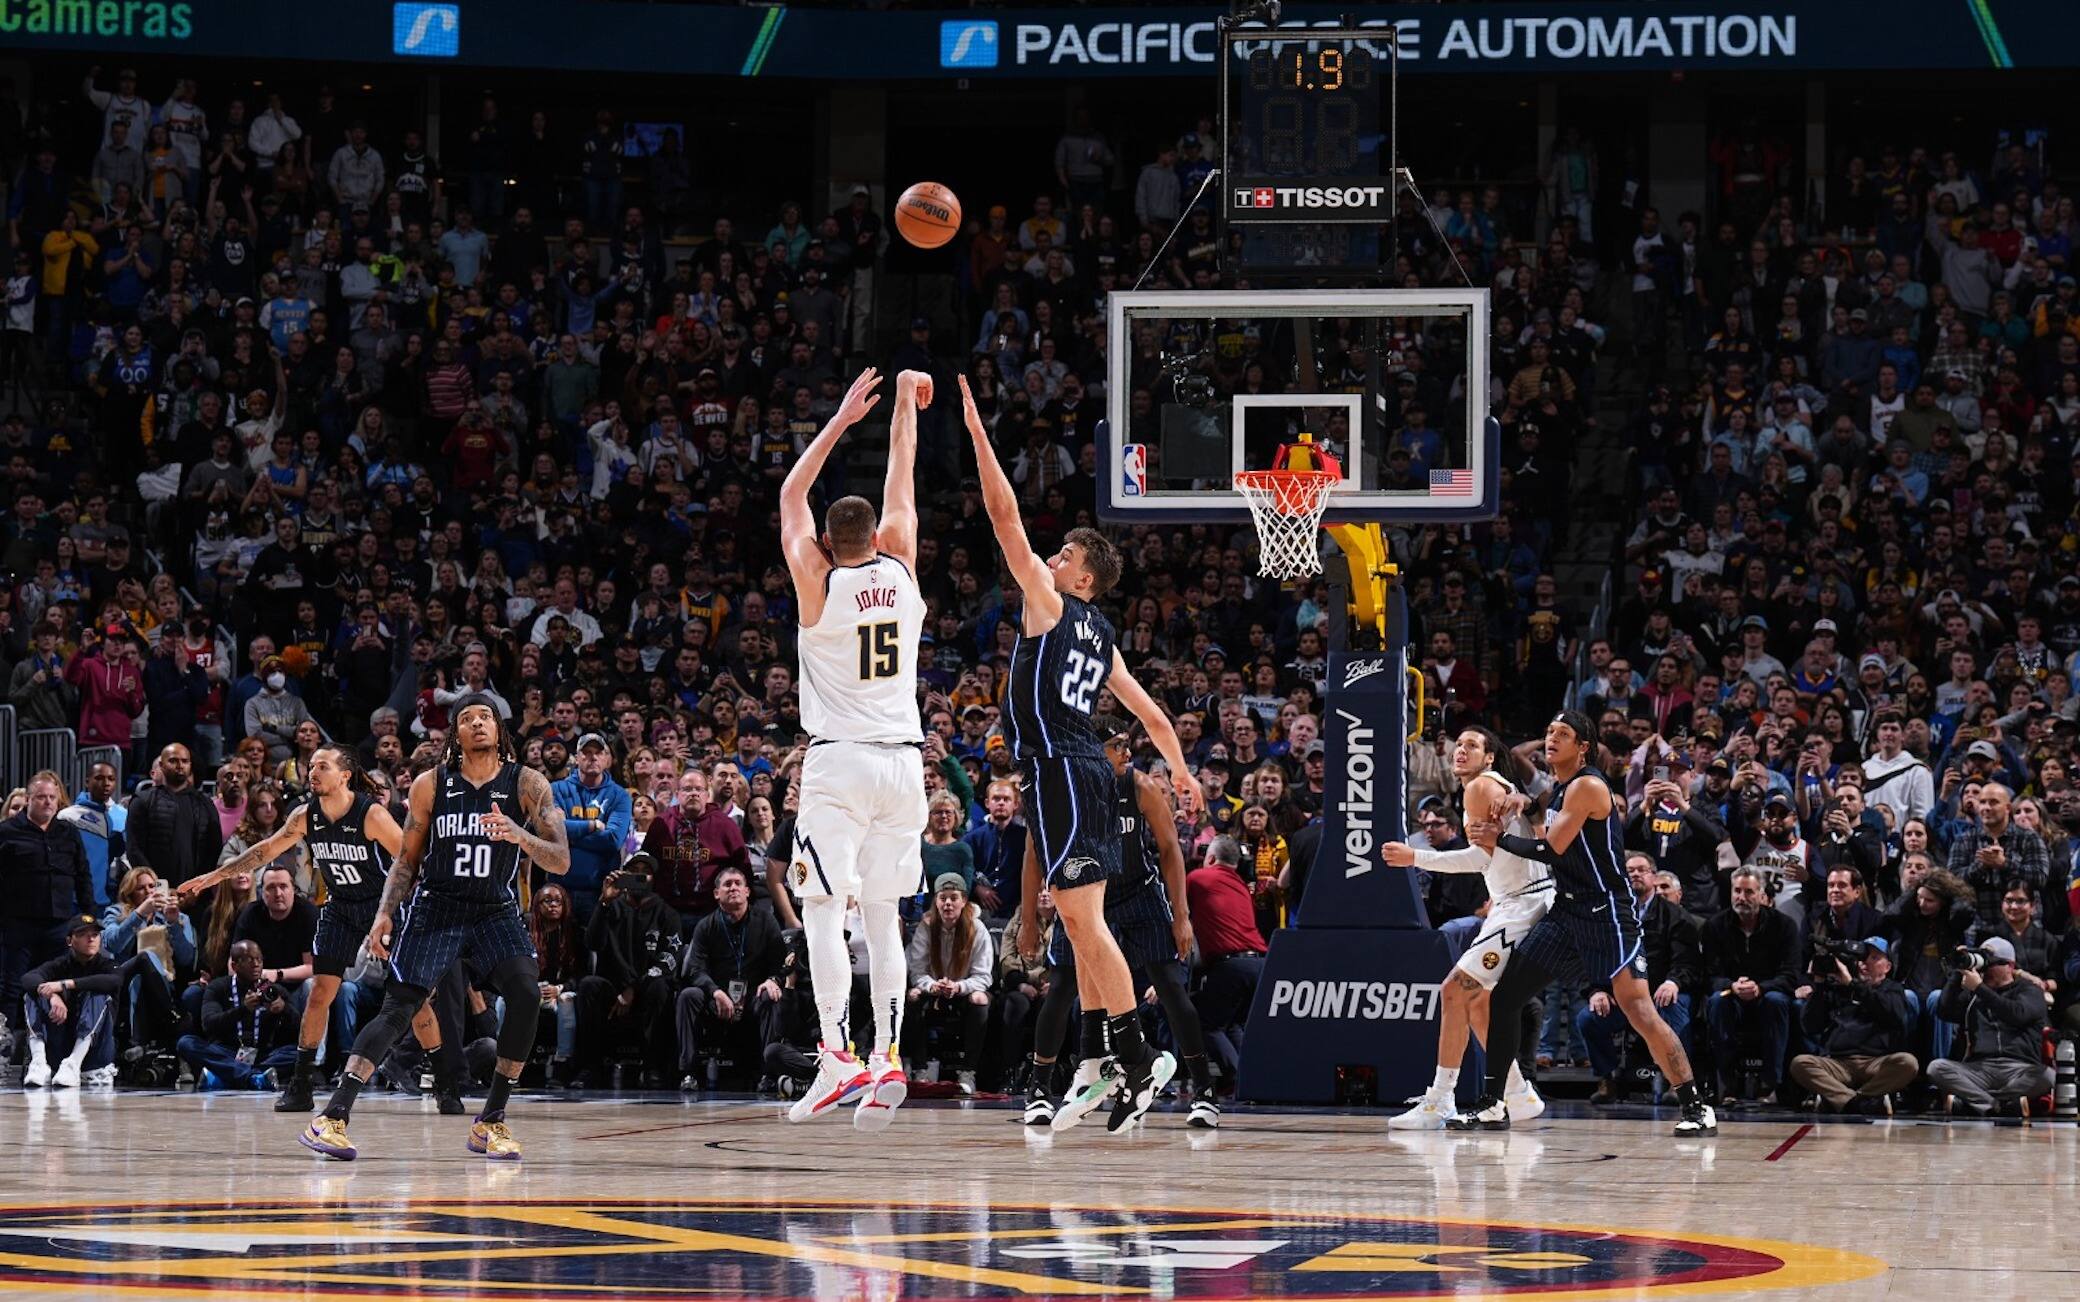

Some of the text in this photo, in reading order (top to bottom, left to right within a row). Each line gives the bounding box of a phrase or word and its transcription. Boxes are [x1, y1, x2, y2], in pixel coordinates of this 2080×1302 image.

[1017, 22, 1215, 63] PACIFIC
[1438, 16, 1796, 58] AUTOMATION
[1296, 48, 1344, 90] 1.9
[1275, 187, 1385, 208] TISSOT
[909, 199, 949, 222] Wilson
[772, 452, 784, 464] 15
[855, 586, 897, 612] JOKIĆ
[196, 652, 212, 668] 27
[857, 621, 899, 681] 15
[1061, 648, 1105, 715] 22
[1344, 658, 1385, 681] Ball
[446, 778, 454, 787] 6
[1338, 727, 1374, 879] verizon
[436, 812, 504, 840] ORLA
[311, 842, 369, 862] ORLANDO
[454, 842, 492, 879] 20
[1756, 854, 1800, 868] DENV
[329, 863, 363, 886] 50
[1269, 980, 1441, 1020] POINTSBET
